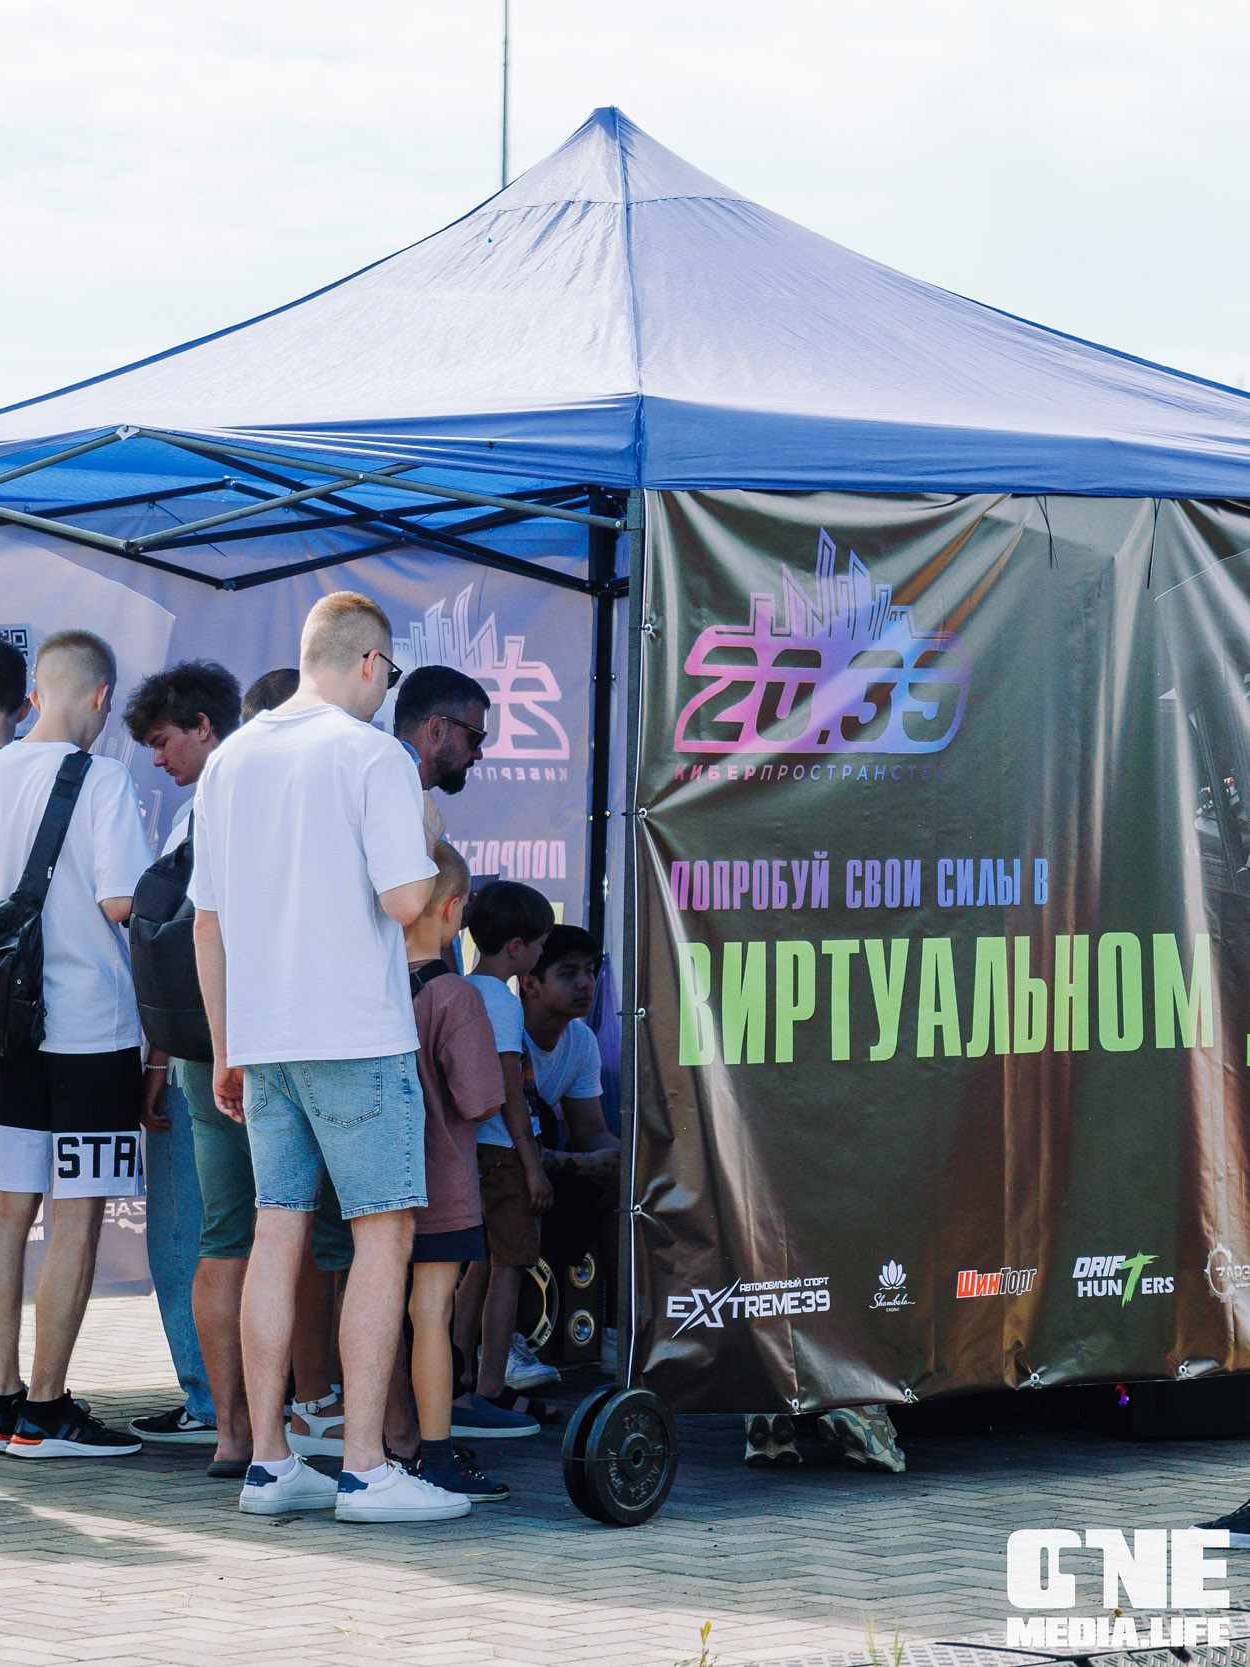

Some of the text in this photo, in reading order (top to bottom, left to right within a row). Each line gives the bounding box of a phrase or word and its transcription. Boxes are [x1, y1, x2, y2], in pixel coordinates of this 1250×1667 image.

[670, 851, 1049, 911] ПОПРОБУЙ СВОИ СИЛЫ В
[677, 931, 1215, 1066] ВИРТУАЛЬНОМ
[739, 1277, 829, 1292] АВТОМОБИЛЬНЫЙ СПОРТ
[1072, 1250, 1159, 1292] DRIFT
